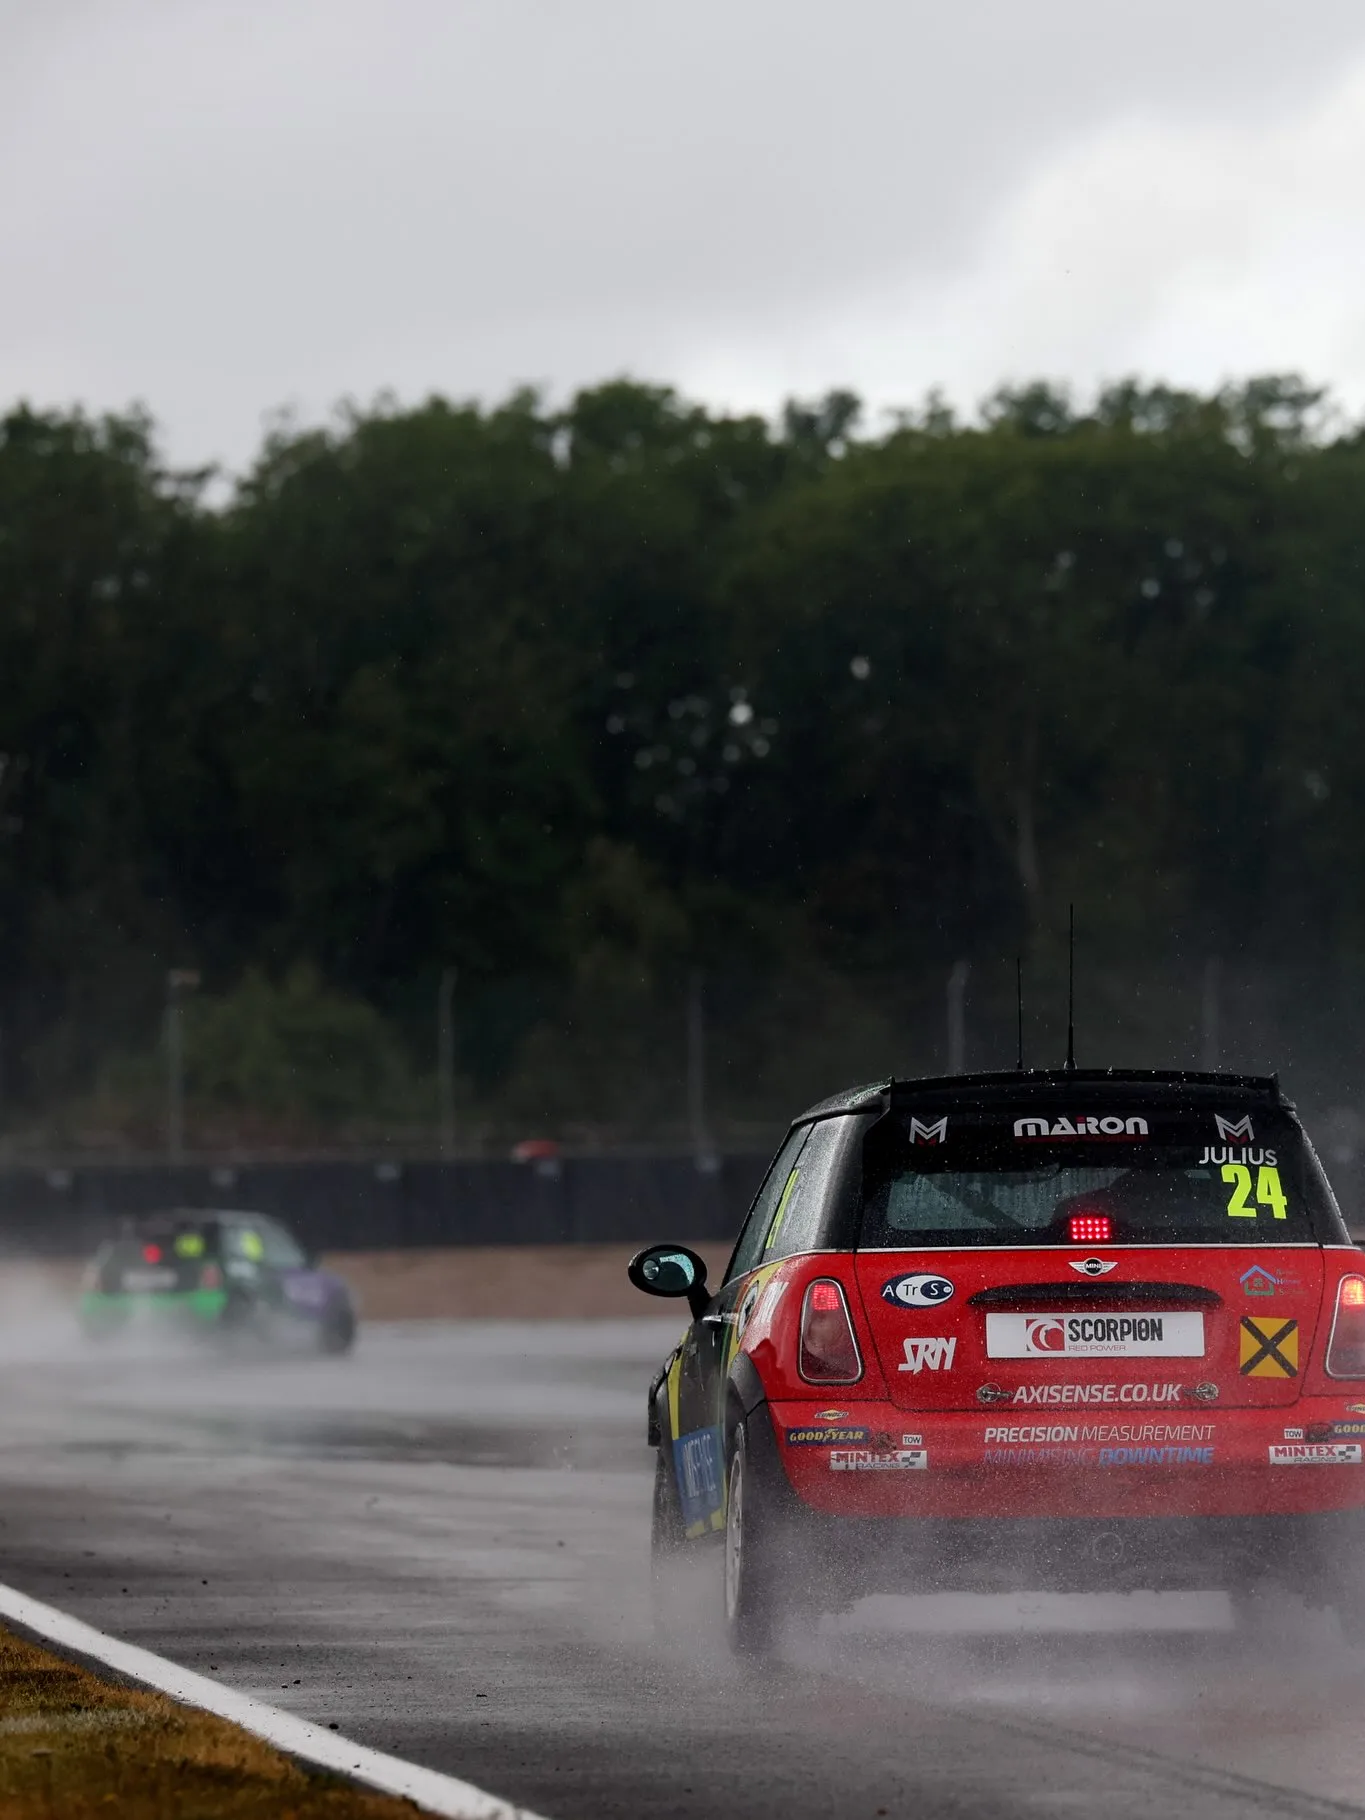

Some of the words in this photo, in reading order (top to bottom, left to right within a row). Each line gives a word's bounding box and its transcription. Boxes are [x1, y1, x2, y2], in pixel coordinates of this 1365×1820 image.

[1198, 1147, 1278, 1167] JULIUS
[1221, 1164, 1288, 1220] 24
[1068, 1318, 1163, 1342] SCORPION
[1013, 1383, 1182, 1404] AXISENSE.CO.UK
[789, 1428, 864, 1442] GOODYEAR
[904, 1436, 921, 1444] TOW
[984, 1426, 1078, 1443] PRECISION
[1081, 1425, 1216, 1441] MEASUREMENT
[1285, 1430, 1301, 1438] TOW
[836, 1452, 900, 1463] MINTEX
[1099, 1447, 1215, 1466] DOWNTIME
[1274, 1446, 1337, 1457] MINTEX
